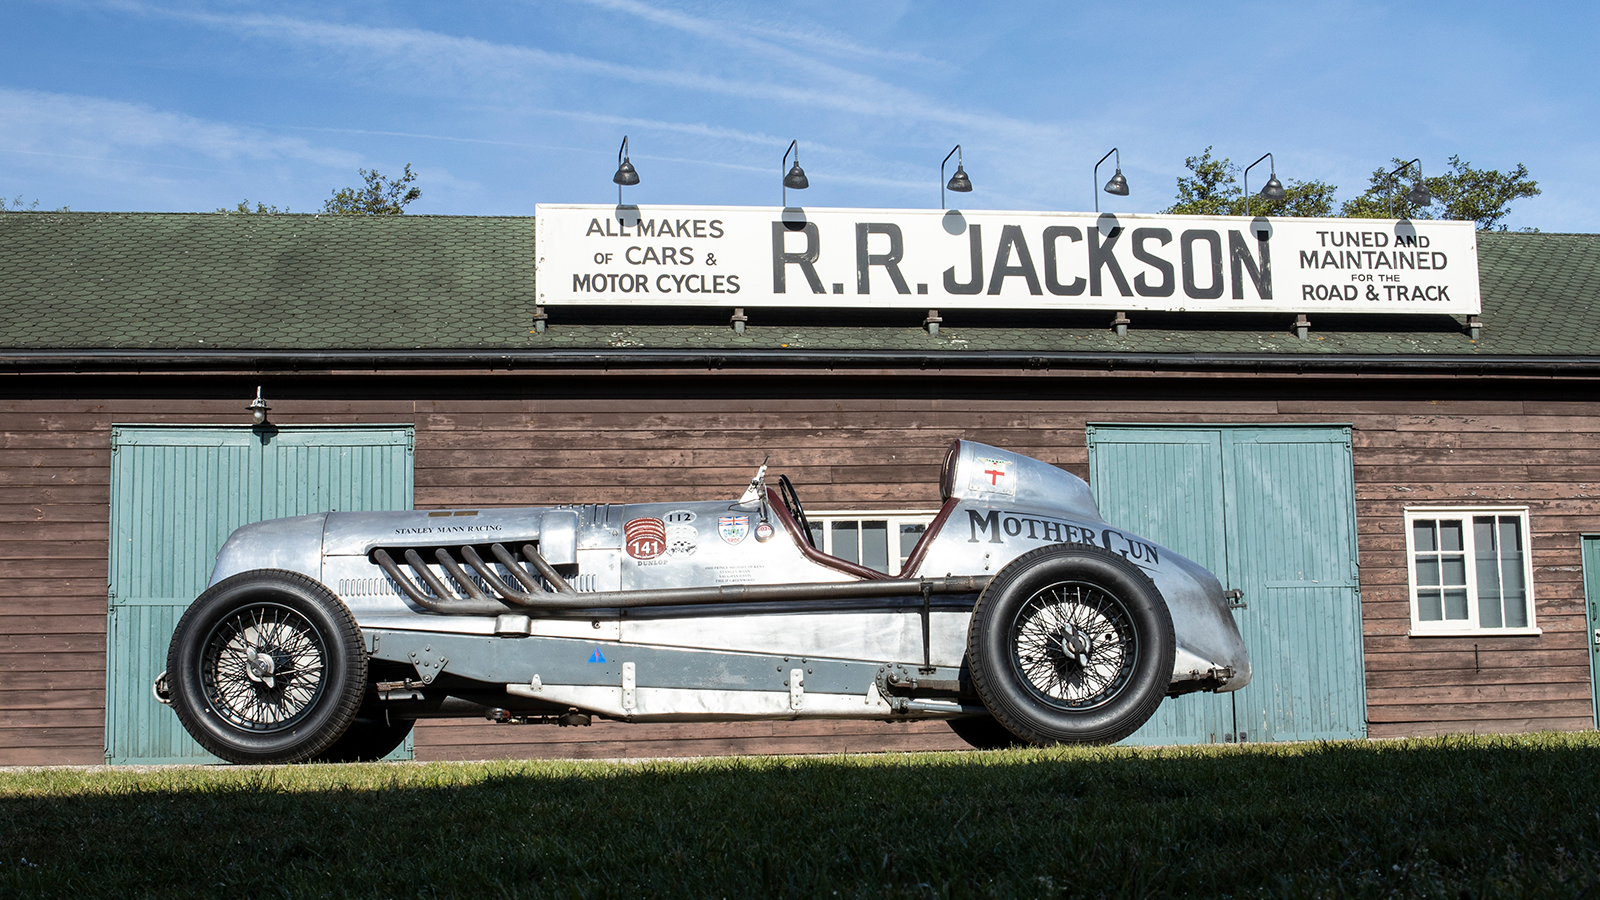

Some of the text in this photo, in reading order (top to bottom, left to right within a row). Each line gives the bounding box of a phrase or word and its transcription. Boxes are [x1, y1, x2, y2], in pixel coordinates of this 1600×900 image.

[586, 218, 724, 239] ALL MAKES
[1316, 231, 1430, 248] TUNED AND
[593, 246, 718, 267] OF CARS &
[1299, 250, 1448, 270] MAINTAINED
[572, 273, 741, 294] MOTOR CYCLES
[1351, 273, 1400, 283] FOR THE
[1302, 284, 1450, 302] ROAD & TRACK
[669, 513, 691, 522] 112
[395, 527, 434, 535] STANLEY
[467, 524, 502, 532] RACING
[964, 509, 1159, 565] MOTHER GUN
[632, 541, 659, 555] 141
